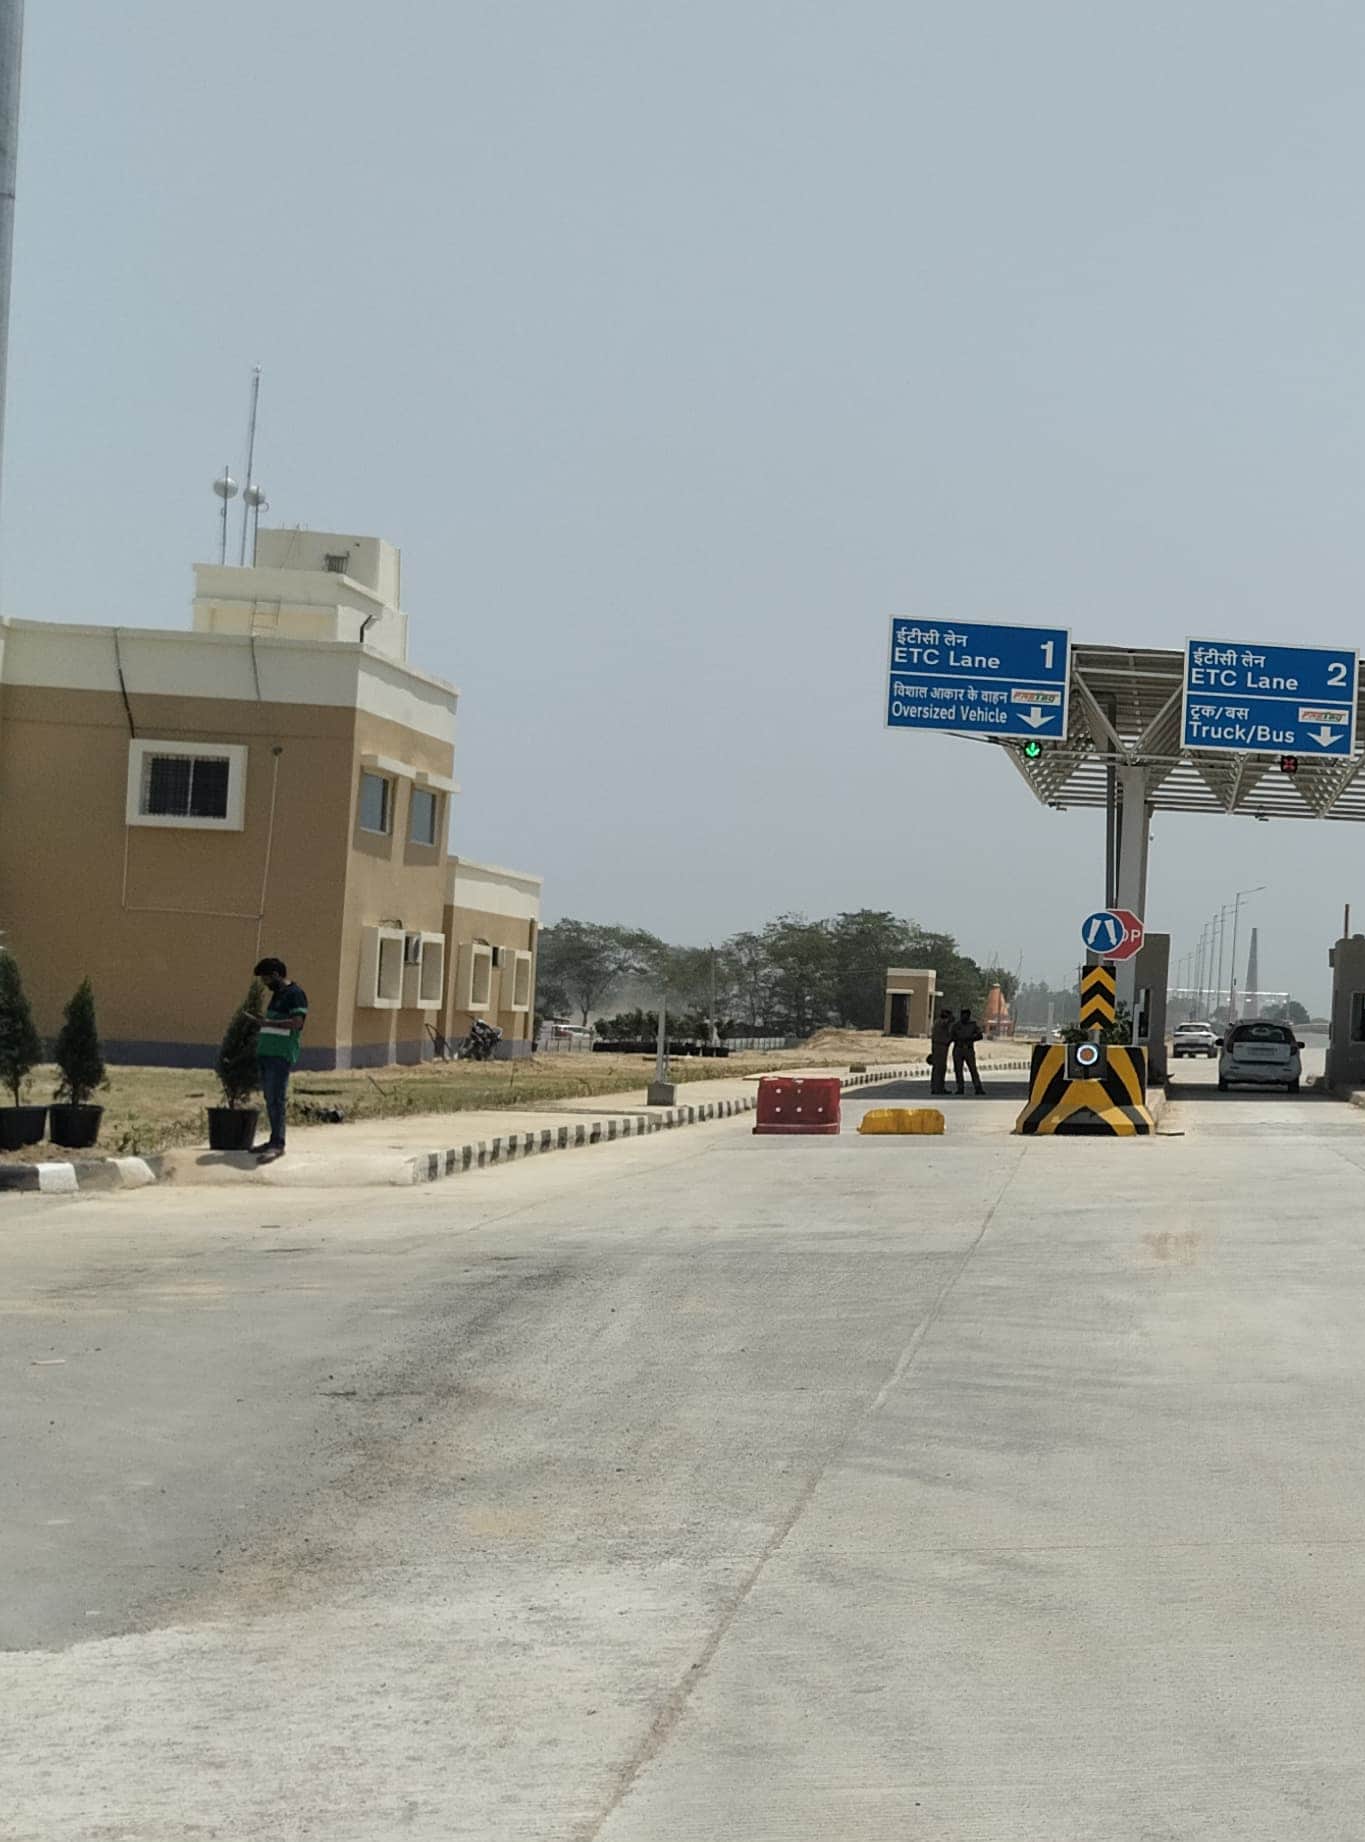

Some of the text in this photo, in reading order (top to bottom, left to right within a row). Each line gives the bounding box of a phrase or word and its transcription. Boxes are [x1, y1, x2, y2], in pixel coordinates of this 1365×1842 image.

[896, 626, 968, 648] ईटीसी लेन
[894, 647, 1001, 669] ETC Lane
[1040, 641, 1054, 669] 1
[1193, 647, 1266, 668] ईटीसी लेन
[1191, 668, 1299, 690] ETC Lane
[1327, 662, 1348, 687] 2
[891, 701, 1007, 724] Oversized Vehicle
[1189, 721, 1295, 744] Truck/Bus
